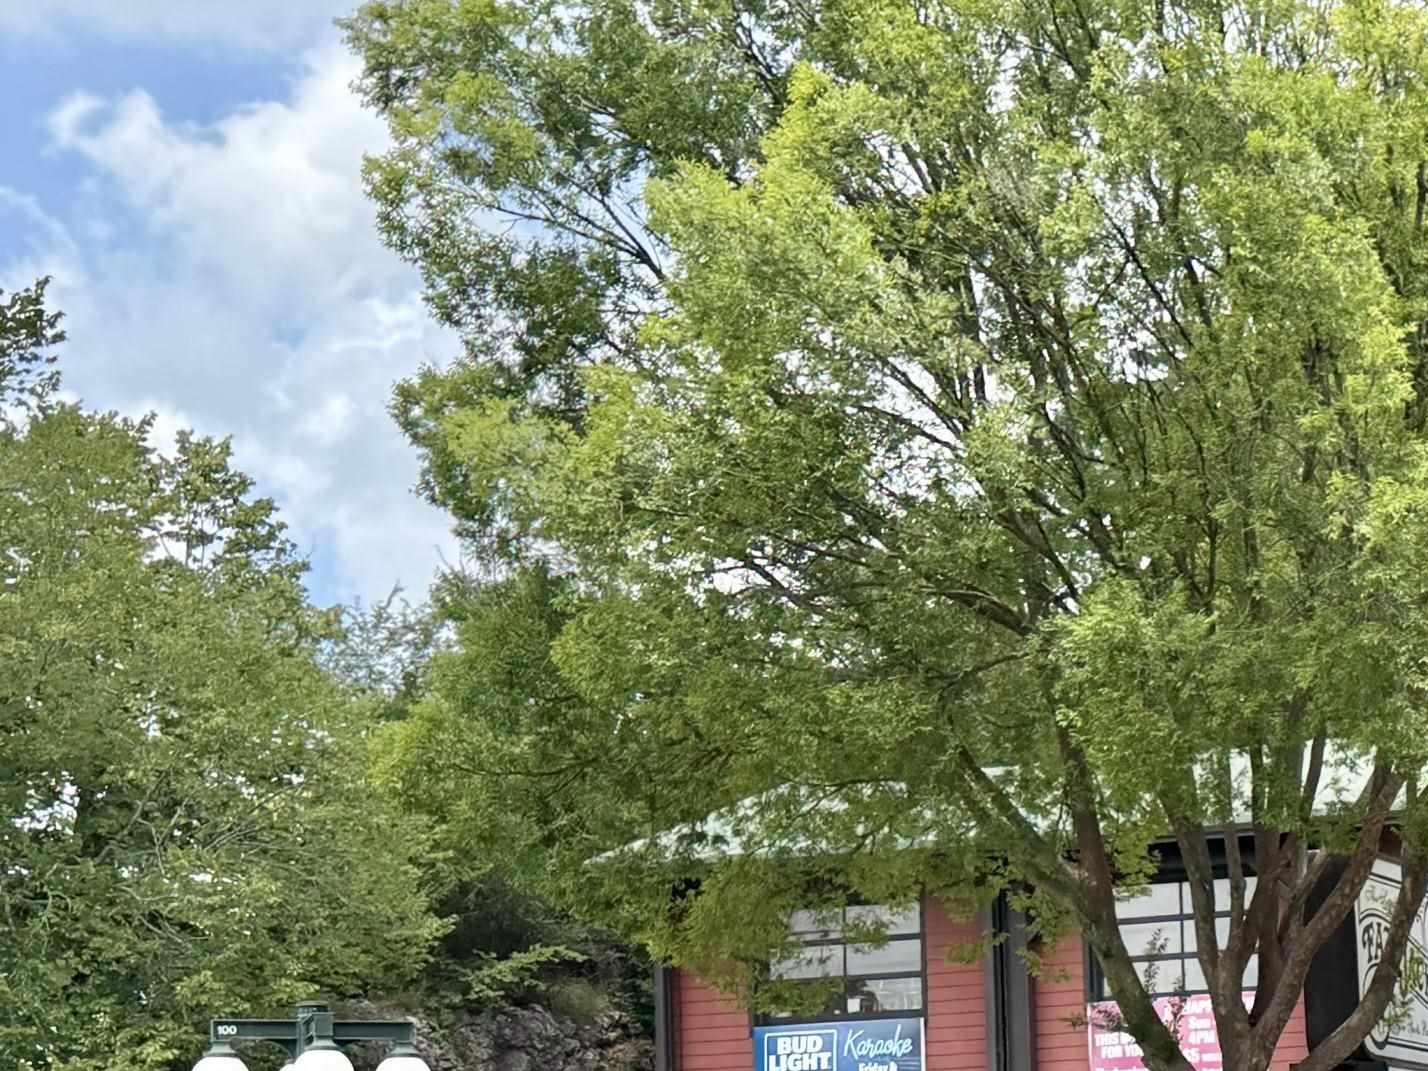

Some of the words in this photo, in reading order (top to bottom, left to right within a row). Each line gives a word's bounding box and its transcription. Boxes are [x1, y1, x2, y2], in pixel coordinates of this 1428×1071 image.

[216, 1025, 238, 1036] 100
[776, 1036, 823, 1055] BUD
[843, 1024, 912, 1059] Karaoke
[1095, 1032, 1119, 1047] THIS
